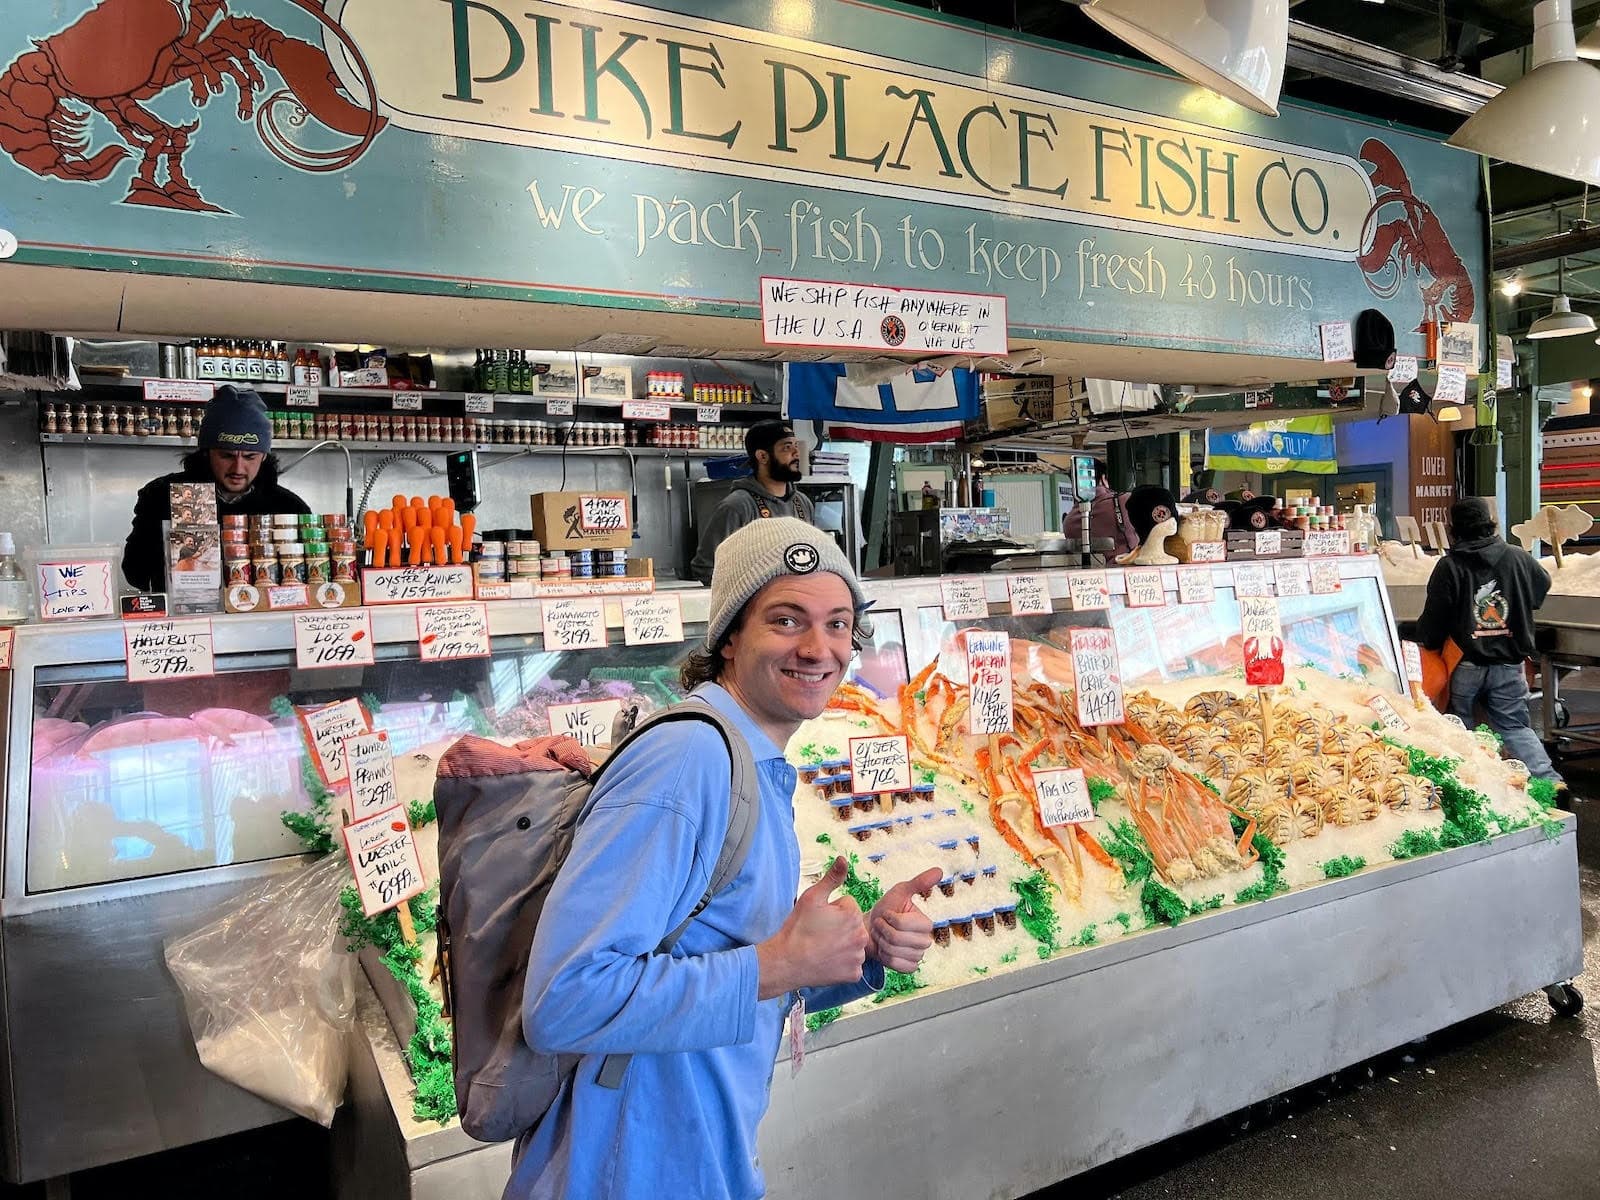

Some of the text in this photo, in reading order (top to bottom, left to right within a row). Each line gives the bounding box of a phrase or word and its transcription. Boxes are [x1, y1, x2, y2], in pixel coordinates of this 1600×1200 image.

[443, 0, 1339, 240] PIKE PLACE FISH CO.
[525, 180, 1313, 312] we pack fish to keep fresh 48 hours
[772, 282, 800, 303] WE
[900, 298, 968, 317] ANYWHERE
[768, 314, 804, 336] THE
[925, 335, 976, 350] VIA UPS
[1031, 380, 1050, 388] PIKE
[1033, 401, 1052, 409] FISH
[1421, 456, 1446, 476] LOWER
[1415, 485, 1453, 498] MARKET
[1421, 507, 1448, 527] LEVELS
[59, 565, 86, 578] WE
[375, 573, 464, 589] OYSTER KNIVES
[547, 610, 600, 622] KUMAMOTO
[305, 623, 350, 631] SLICED
[425, 623, 447, 632] KING
[314, 632, 344, 645] LOX
[968, 634, 1004, 653] GENUINE
[1076, 655, 1114, 674] BAIRDI
[981, 669, 1003, 685] RED
[1080, 674, 1110, 693] CRAB
[973, 687, 1000, 706] KING
[565, 706, 593, 729] WE
[981, 701, 1008, 717] CRAB
[856, 740, 901, 758] OYSTER
[855, 754, 906, 768] SHOOTERS
[354, 762, 392, 787] PRAWNS
[1038, 779, 1078, 799] TAG US
[358, 835, 412, 868] LOBSTER
